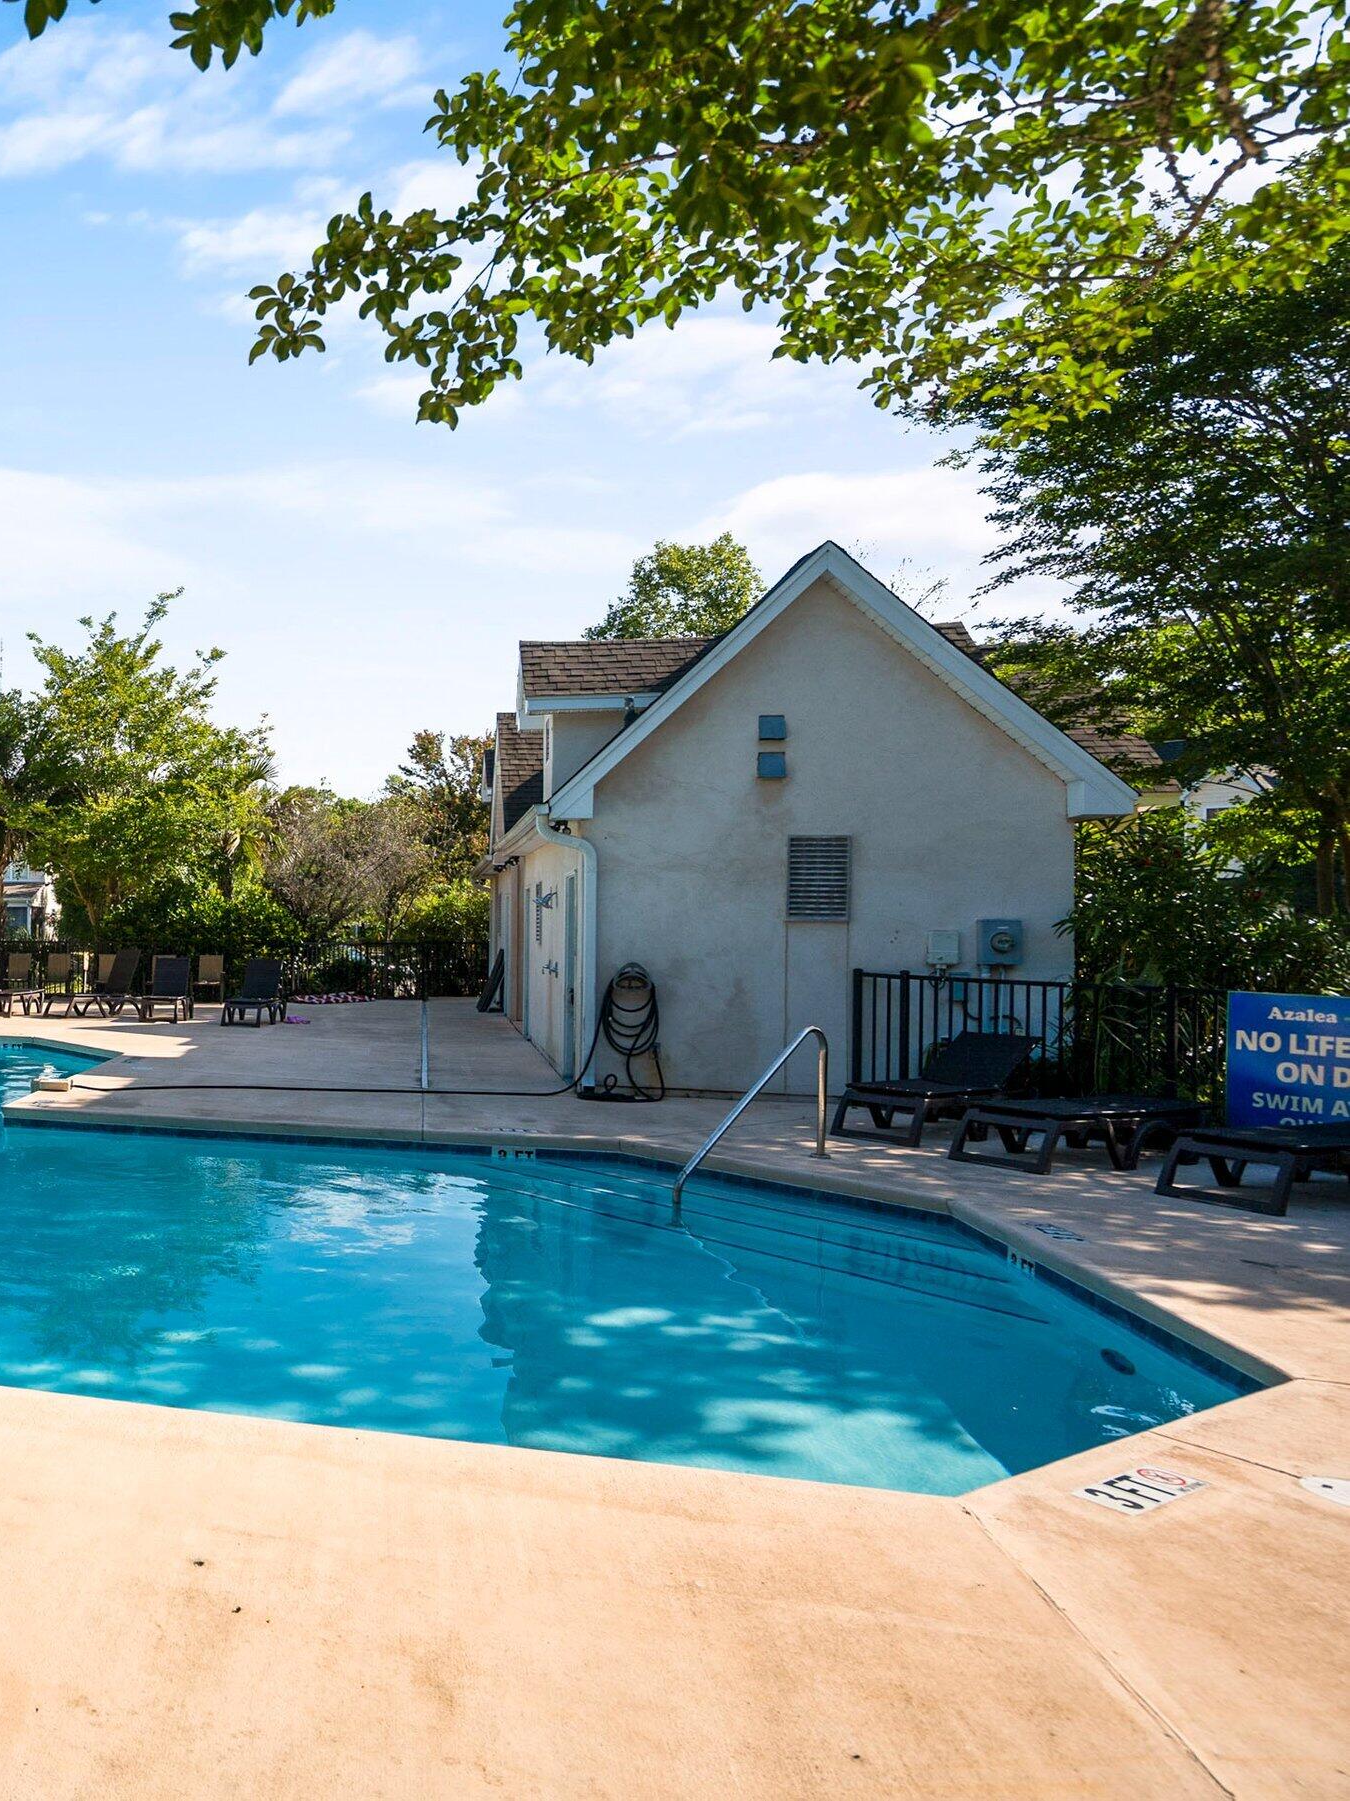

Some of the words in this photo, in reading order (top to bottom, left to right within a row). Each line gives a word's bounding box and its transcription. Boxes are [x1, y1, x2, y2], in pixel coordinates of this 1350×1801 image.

[1267, 1006, 1338, 1024] Azalea
[1235, 1029, 1282, 1053] NO
[1275, 1061, 1325, 1086] ON
[1252, 1091, 1324, 1115] SWIM
[1084, 1488, 1145, 1510] 3
[1103, 1474, 1177, 1503] FT
